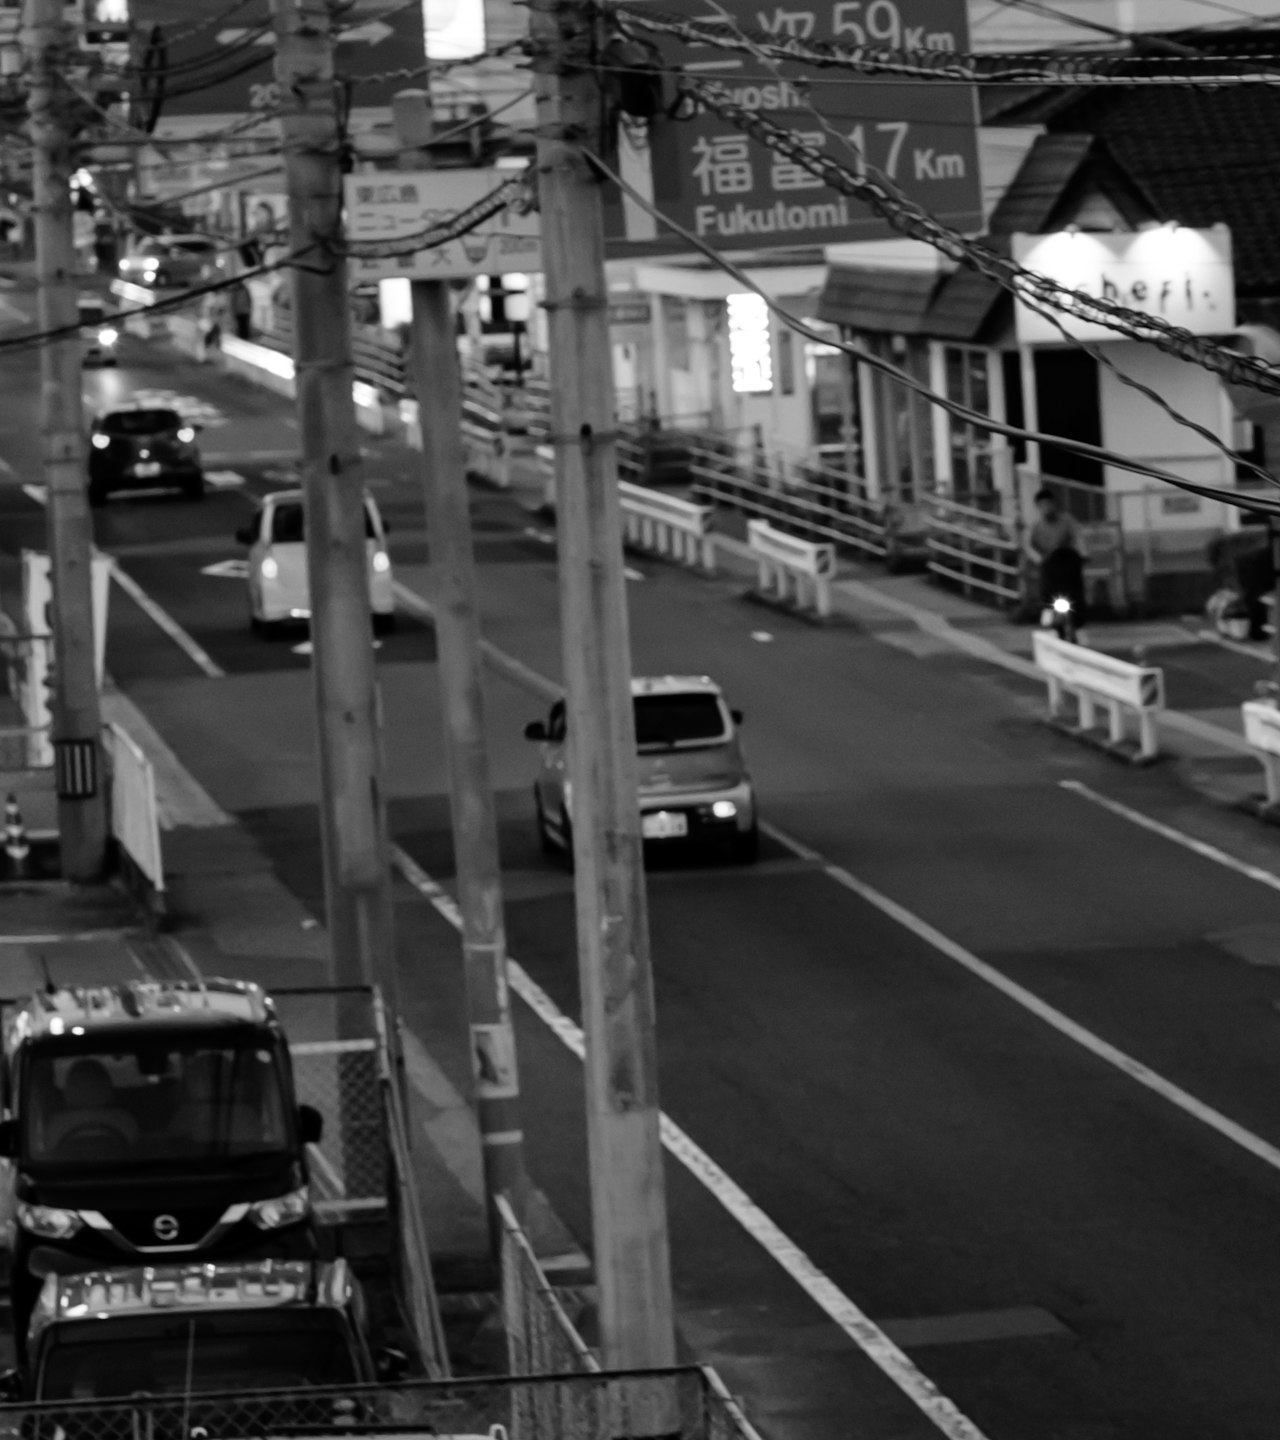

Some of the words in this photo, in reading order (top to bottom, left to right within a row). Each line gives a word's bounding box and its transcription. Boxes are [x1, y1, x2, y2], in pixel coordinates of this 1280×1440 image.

[833, 0, 900, 50] 59
[850, 122, 909, 179] 17
[913, 149, 965, 180] Km
[695, 197, 849, 237] Fukutomi
